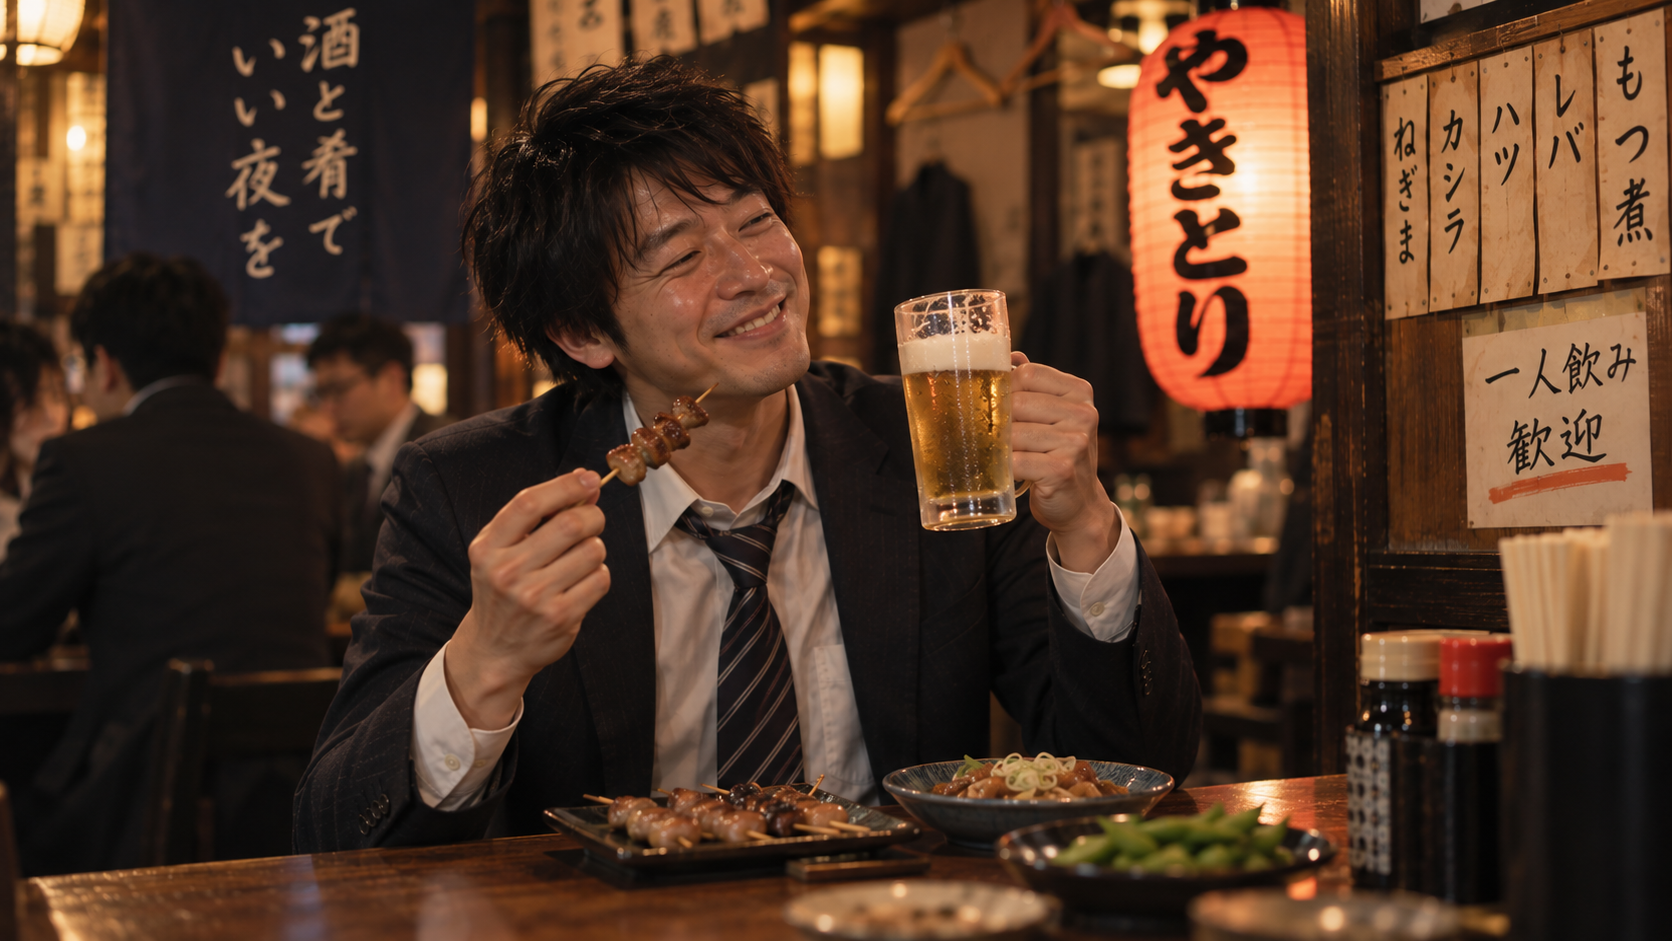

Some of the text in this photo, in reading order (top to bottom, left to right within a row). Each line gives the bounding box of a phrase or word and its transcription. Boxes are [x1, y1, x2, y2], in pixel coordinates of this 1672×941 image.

[225, 38, 291, 279] いい夜を
[298, 8, 361, 256] 酒と肴で
[1393, 116, 1418, 265] ねぎま
[1441, 109, 1466, 255] カシラ
[1491, 102, 1520, 187] ハツ
[1548, 73, 1585, 170] レバ
[1613, 45, 1653, 248] もつ煮
[1156, 29, 1250, 378] やきとり
[1485, 342, 1637, 399] 一人飲み
[1506, 408, 1607, 475] 歓迎
